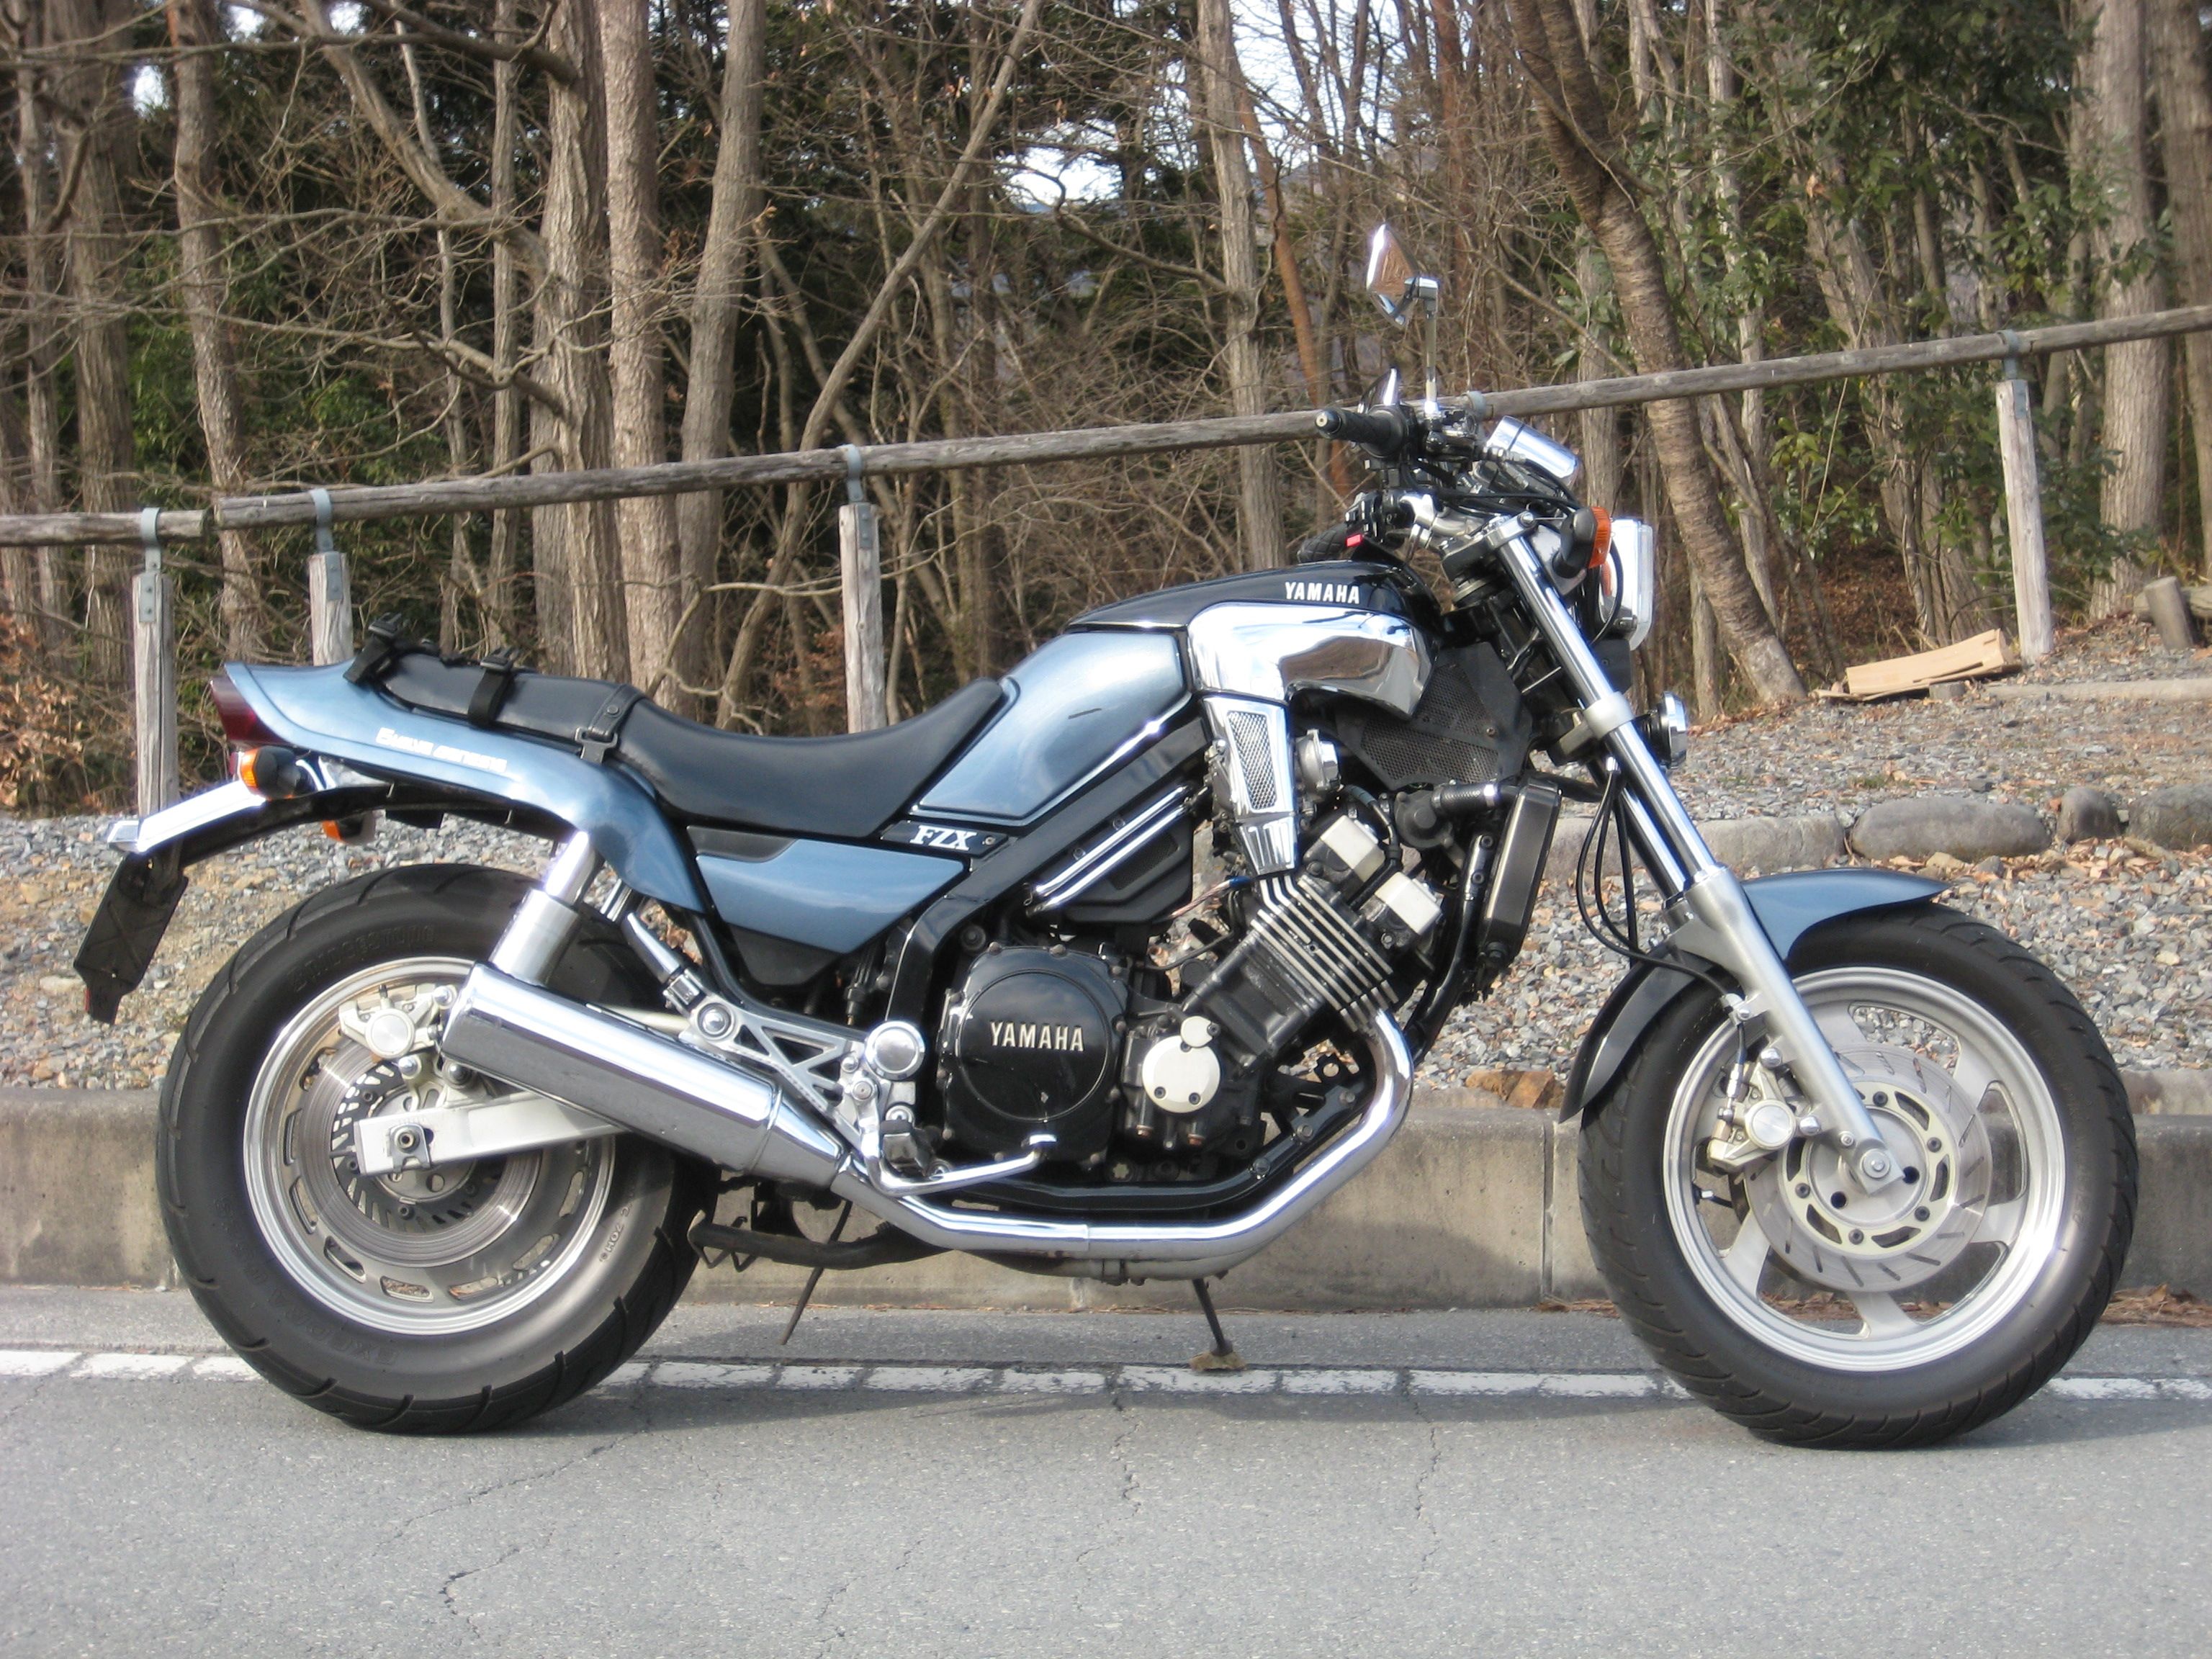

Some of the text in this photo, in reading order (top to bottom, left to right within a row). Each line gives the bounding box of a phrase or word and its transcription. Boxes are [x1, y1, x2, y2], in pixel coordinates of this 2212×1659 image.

[1285, 581, 1360, 604] YAMAHA
[909, 824, 977, 851] FZX
[991, 1021, 1084, 1051] YAMAHA
